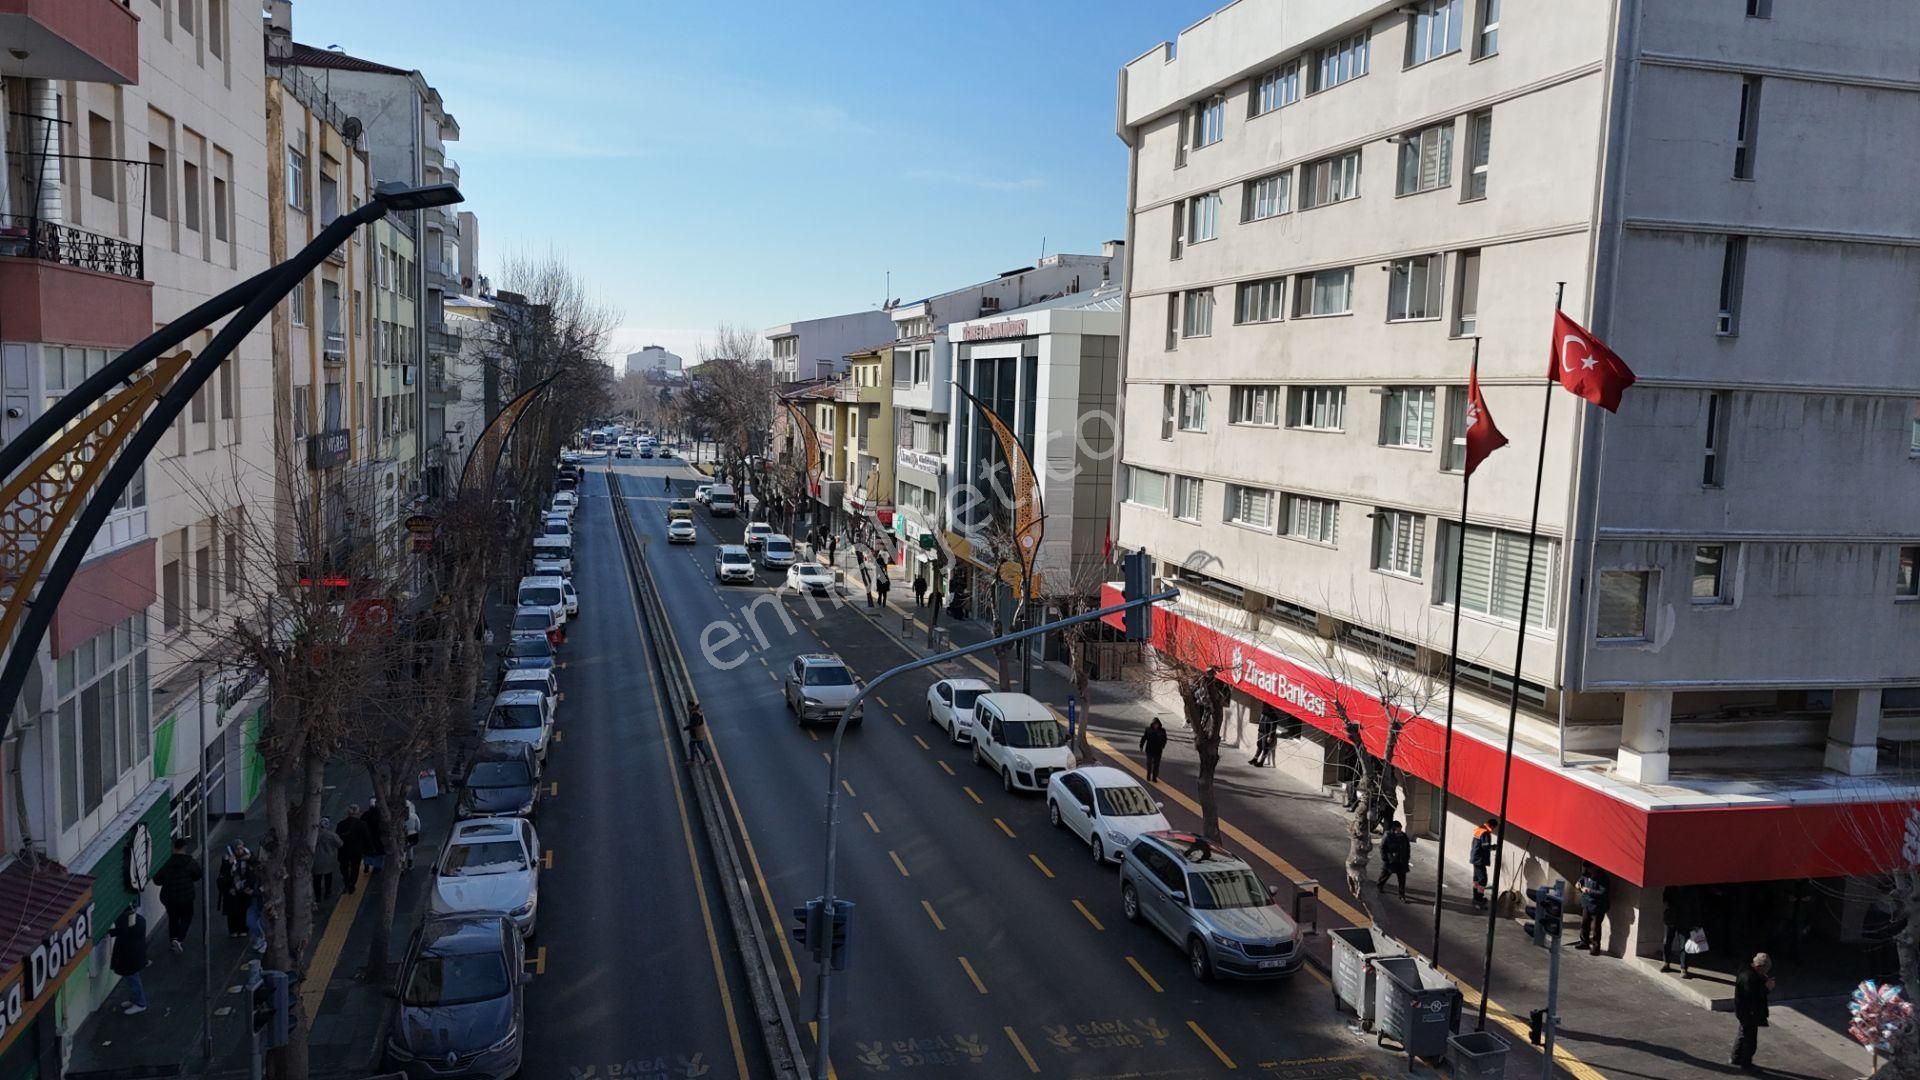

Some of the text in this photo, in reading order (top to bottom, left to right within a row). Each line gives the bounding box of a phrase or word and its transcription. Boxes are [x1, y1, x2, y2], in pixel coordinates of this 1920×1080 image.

[1244, 659, 1327, 718] Ziraat Bankası
[31, 902, 95, 1000] Döner
